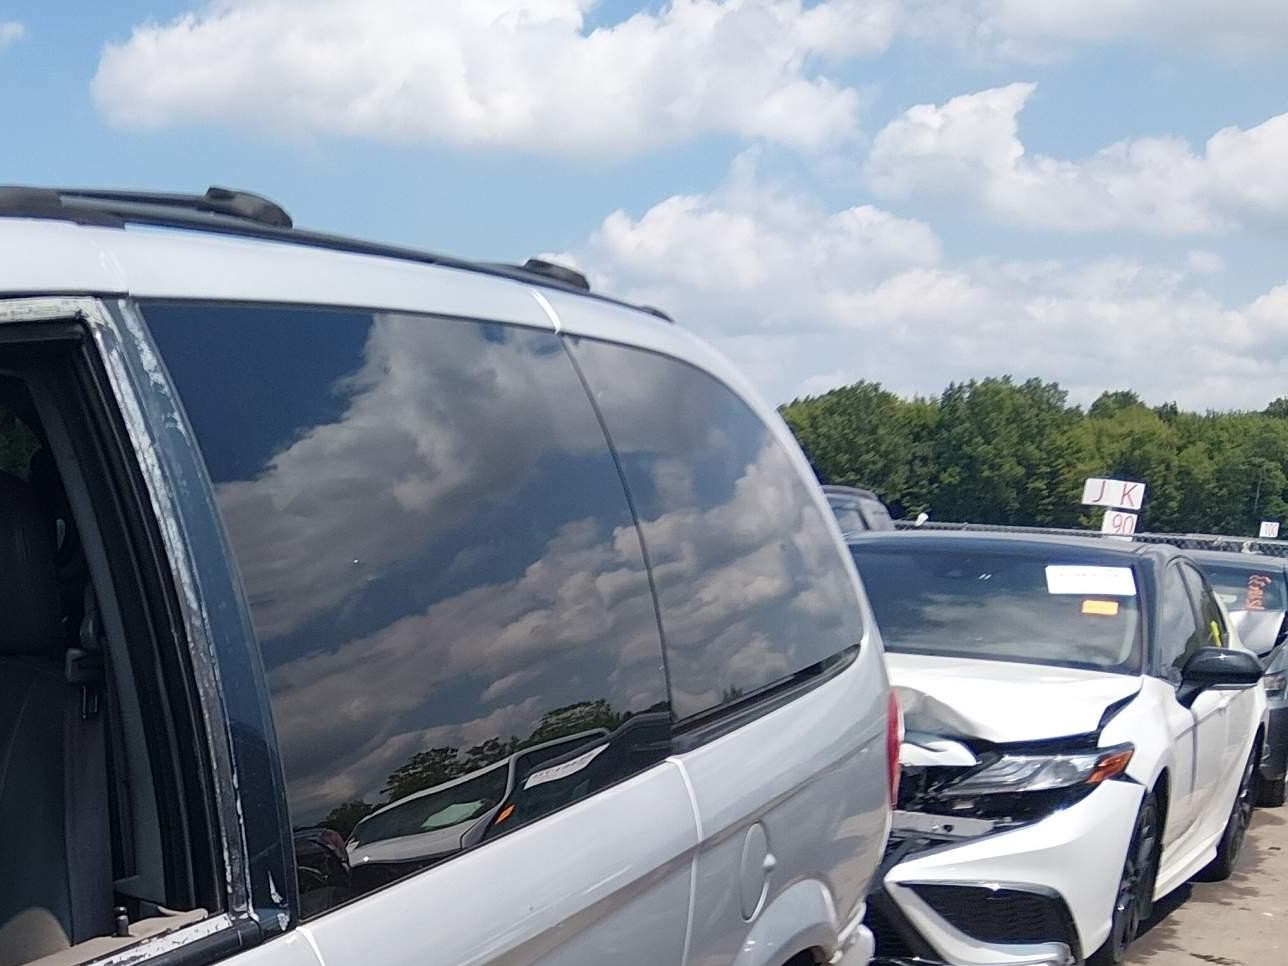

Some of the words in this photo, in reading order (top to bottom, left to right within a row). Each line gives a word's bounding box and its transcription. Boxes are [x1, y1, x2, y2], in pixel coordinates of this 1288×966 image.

[1092, 481, 1105, 503] J
[1120, 482, 1138, 507] K
[1112, 513, 1134, 534] 90
